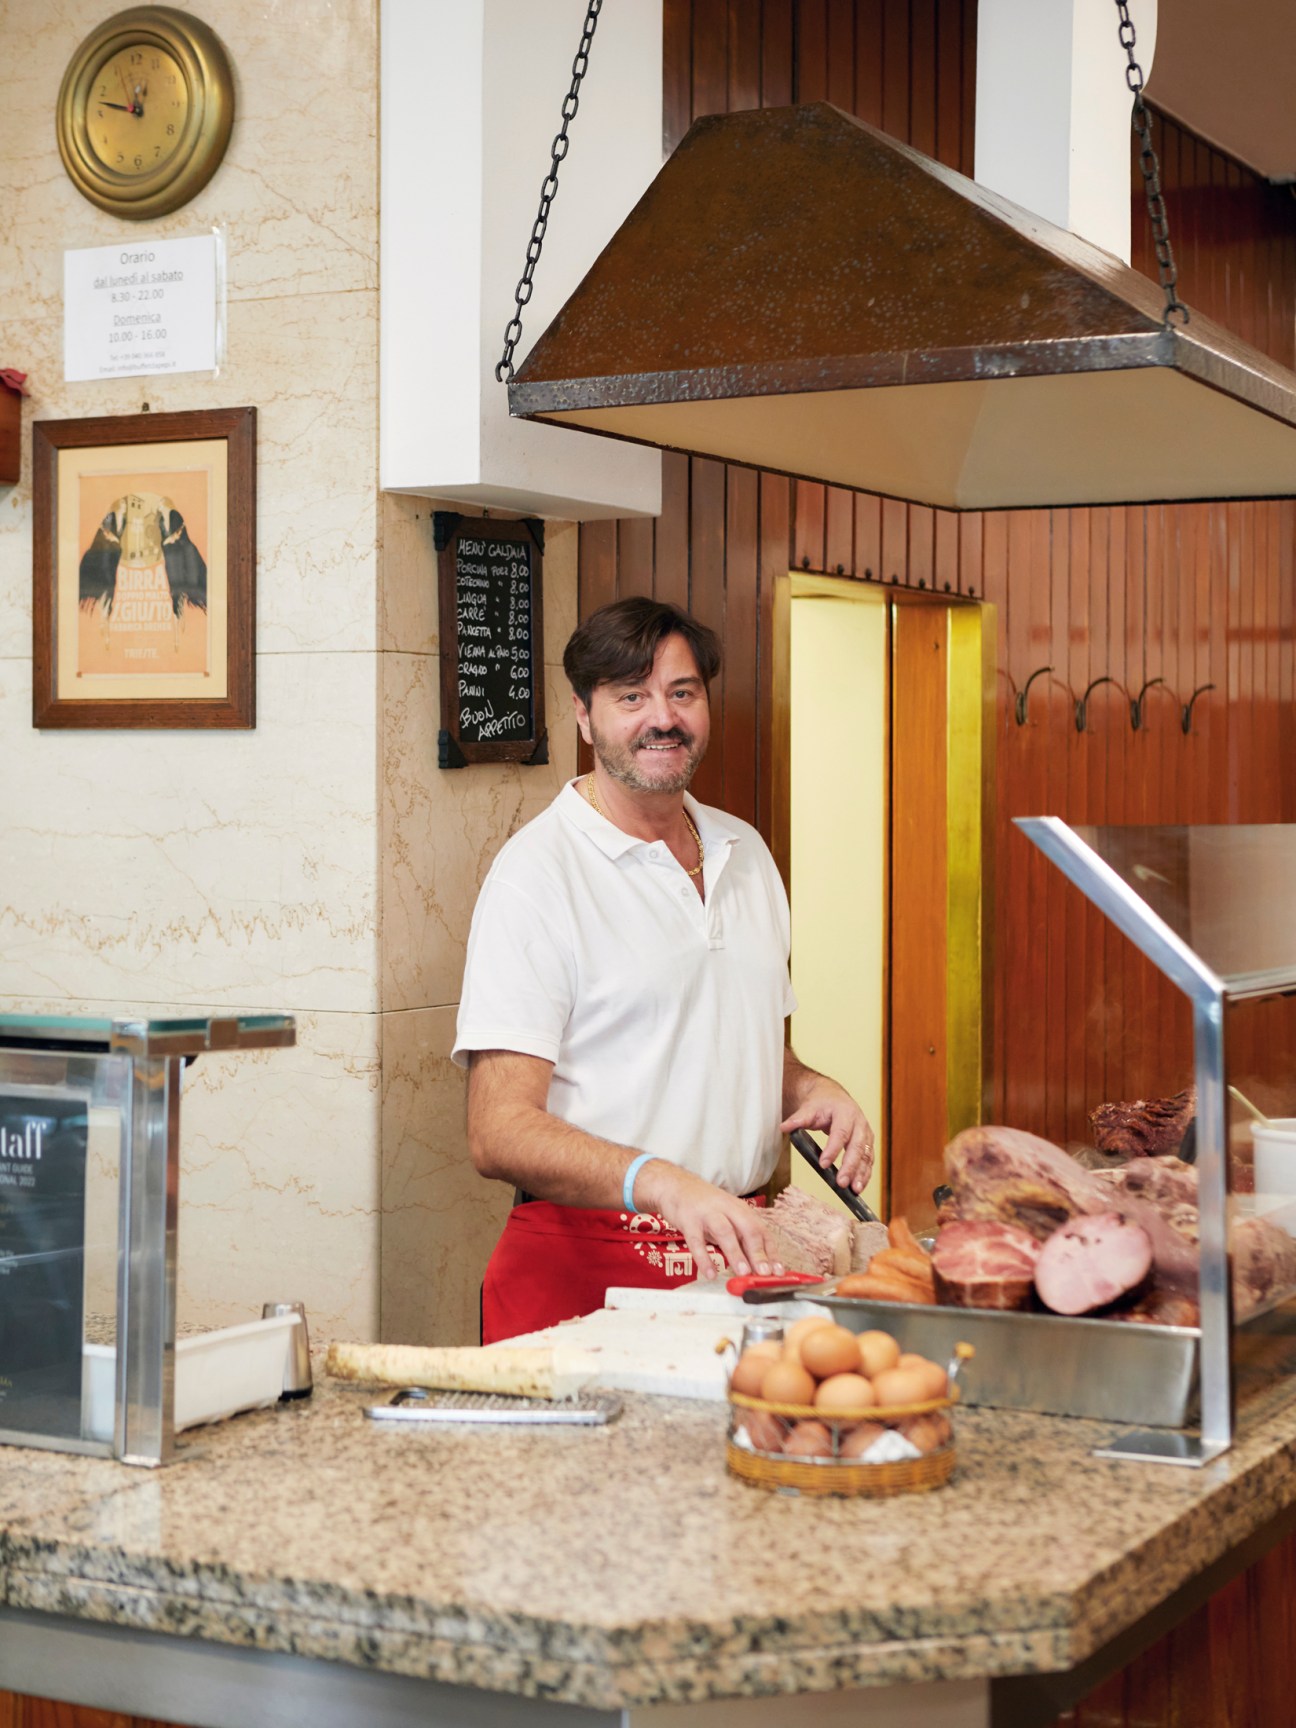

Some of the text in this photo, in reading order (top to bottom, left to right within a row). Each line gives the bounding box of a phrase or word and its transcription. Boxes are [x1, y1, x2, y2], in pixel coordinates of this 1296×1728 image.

[130, 53, 143, 65] 12
[150, 58, 160, 70] 11
[99, 85, 106, 97] 2
[166, 124, 175, 136] 8
[134, 155, 142, 167] 6
[119, 250, 155, 265] Orario
[93, 276, 107, 288] dal
[140, 271, 148, 283] al
[151, 269, 183, 282] sabato
[111, 291, 129, 302] 8.30
[138, 288, 164, 300] 22.00
[113, 312, 161, 326] Domenica
[108, 330, 132, 343] 10.00
[142, 328, 167, 340] 16.00
[488, 543, 528, 561] CALDAIA
[117, 564, 166, 591] BIRRA
[457, 591, 487, 606] LINGUA
[457, 621, 492, 639] PANCETTA
[457, 642, 486, 658] VIENNA
[458, 679, 485, 698] PANINI
[459, 698, 494, 729] BUON
[12, 1162, 34, 1175] GUIDE
[19, 1175, 36, 1188] 2022
